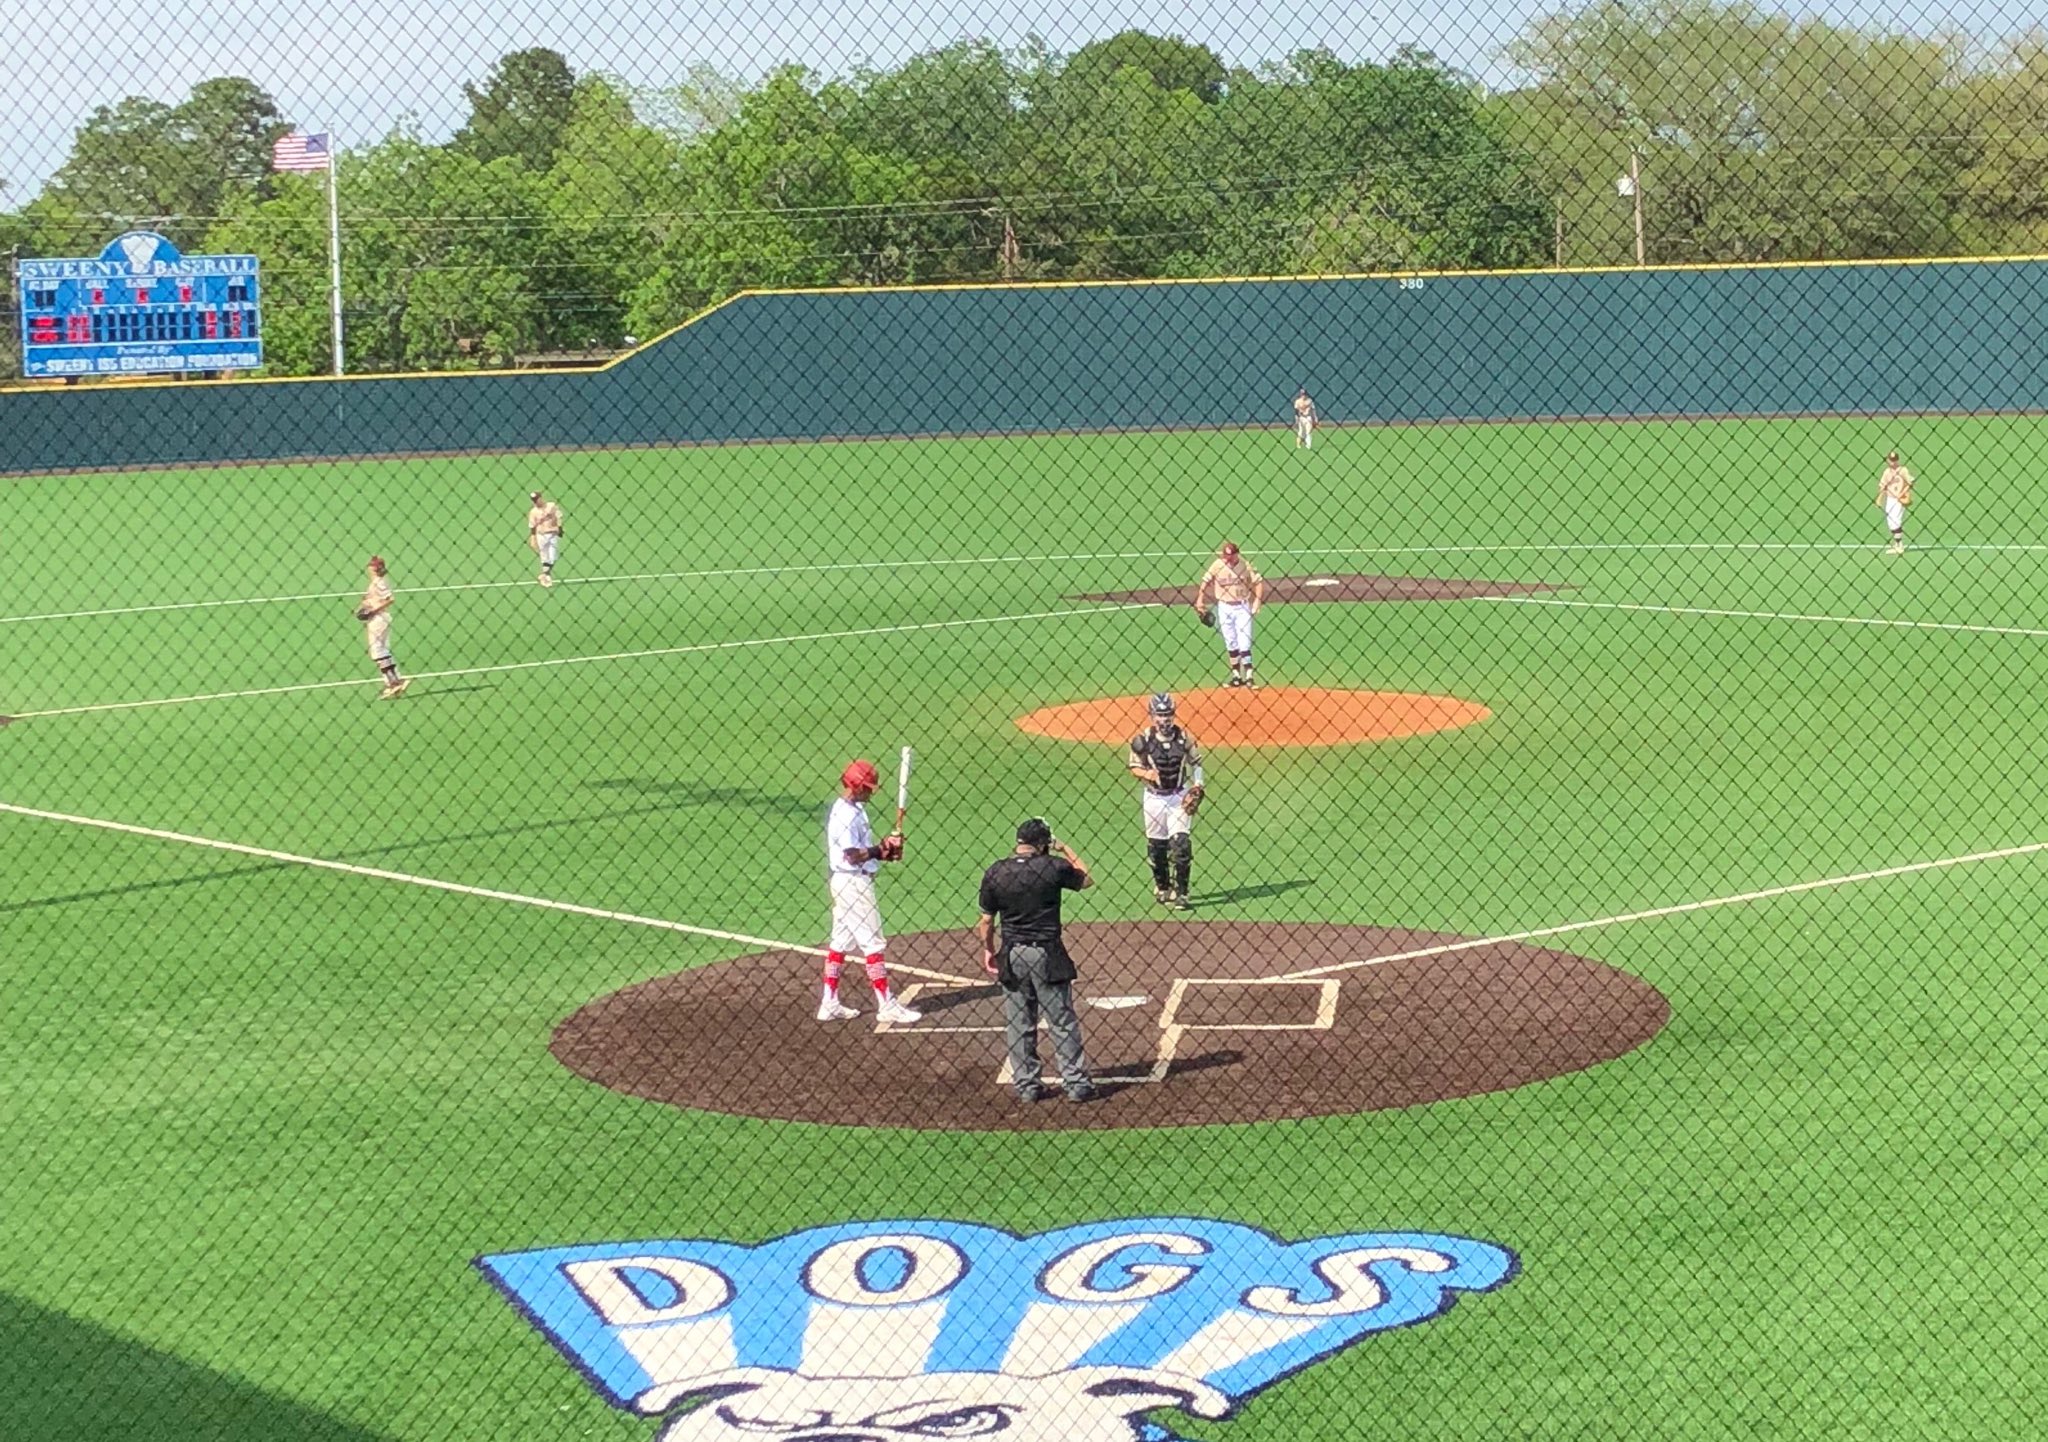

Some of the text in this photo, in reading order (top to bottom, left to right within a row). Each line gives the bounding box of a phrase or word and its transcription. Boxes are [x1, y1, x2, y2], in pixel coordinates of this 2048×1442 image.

[24, 258, 255, 277] SWEENY BASEBALL
[1399, 277, 1424, 290] 380
[558, 1231, 1458, 1327] DOGS
